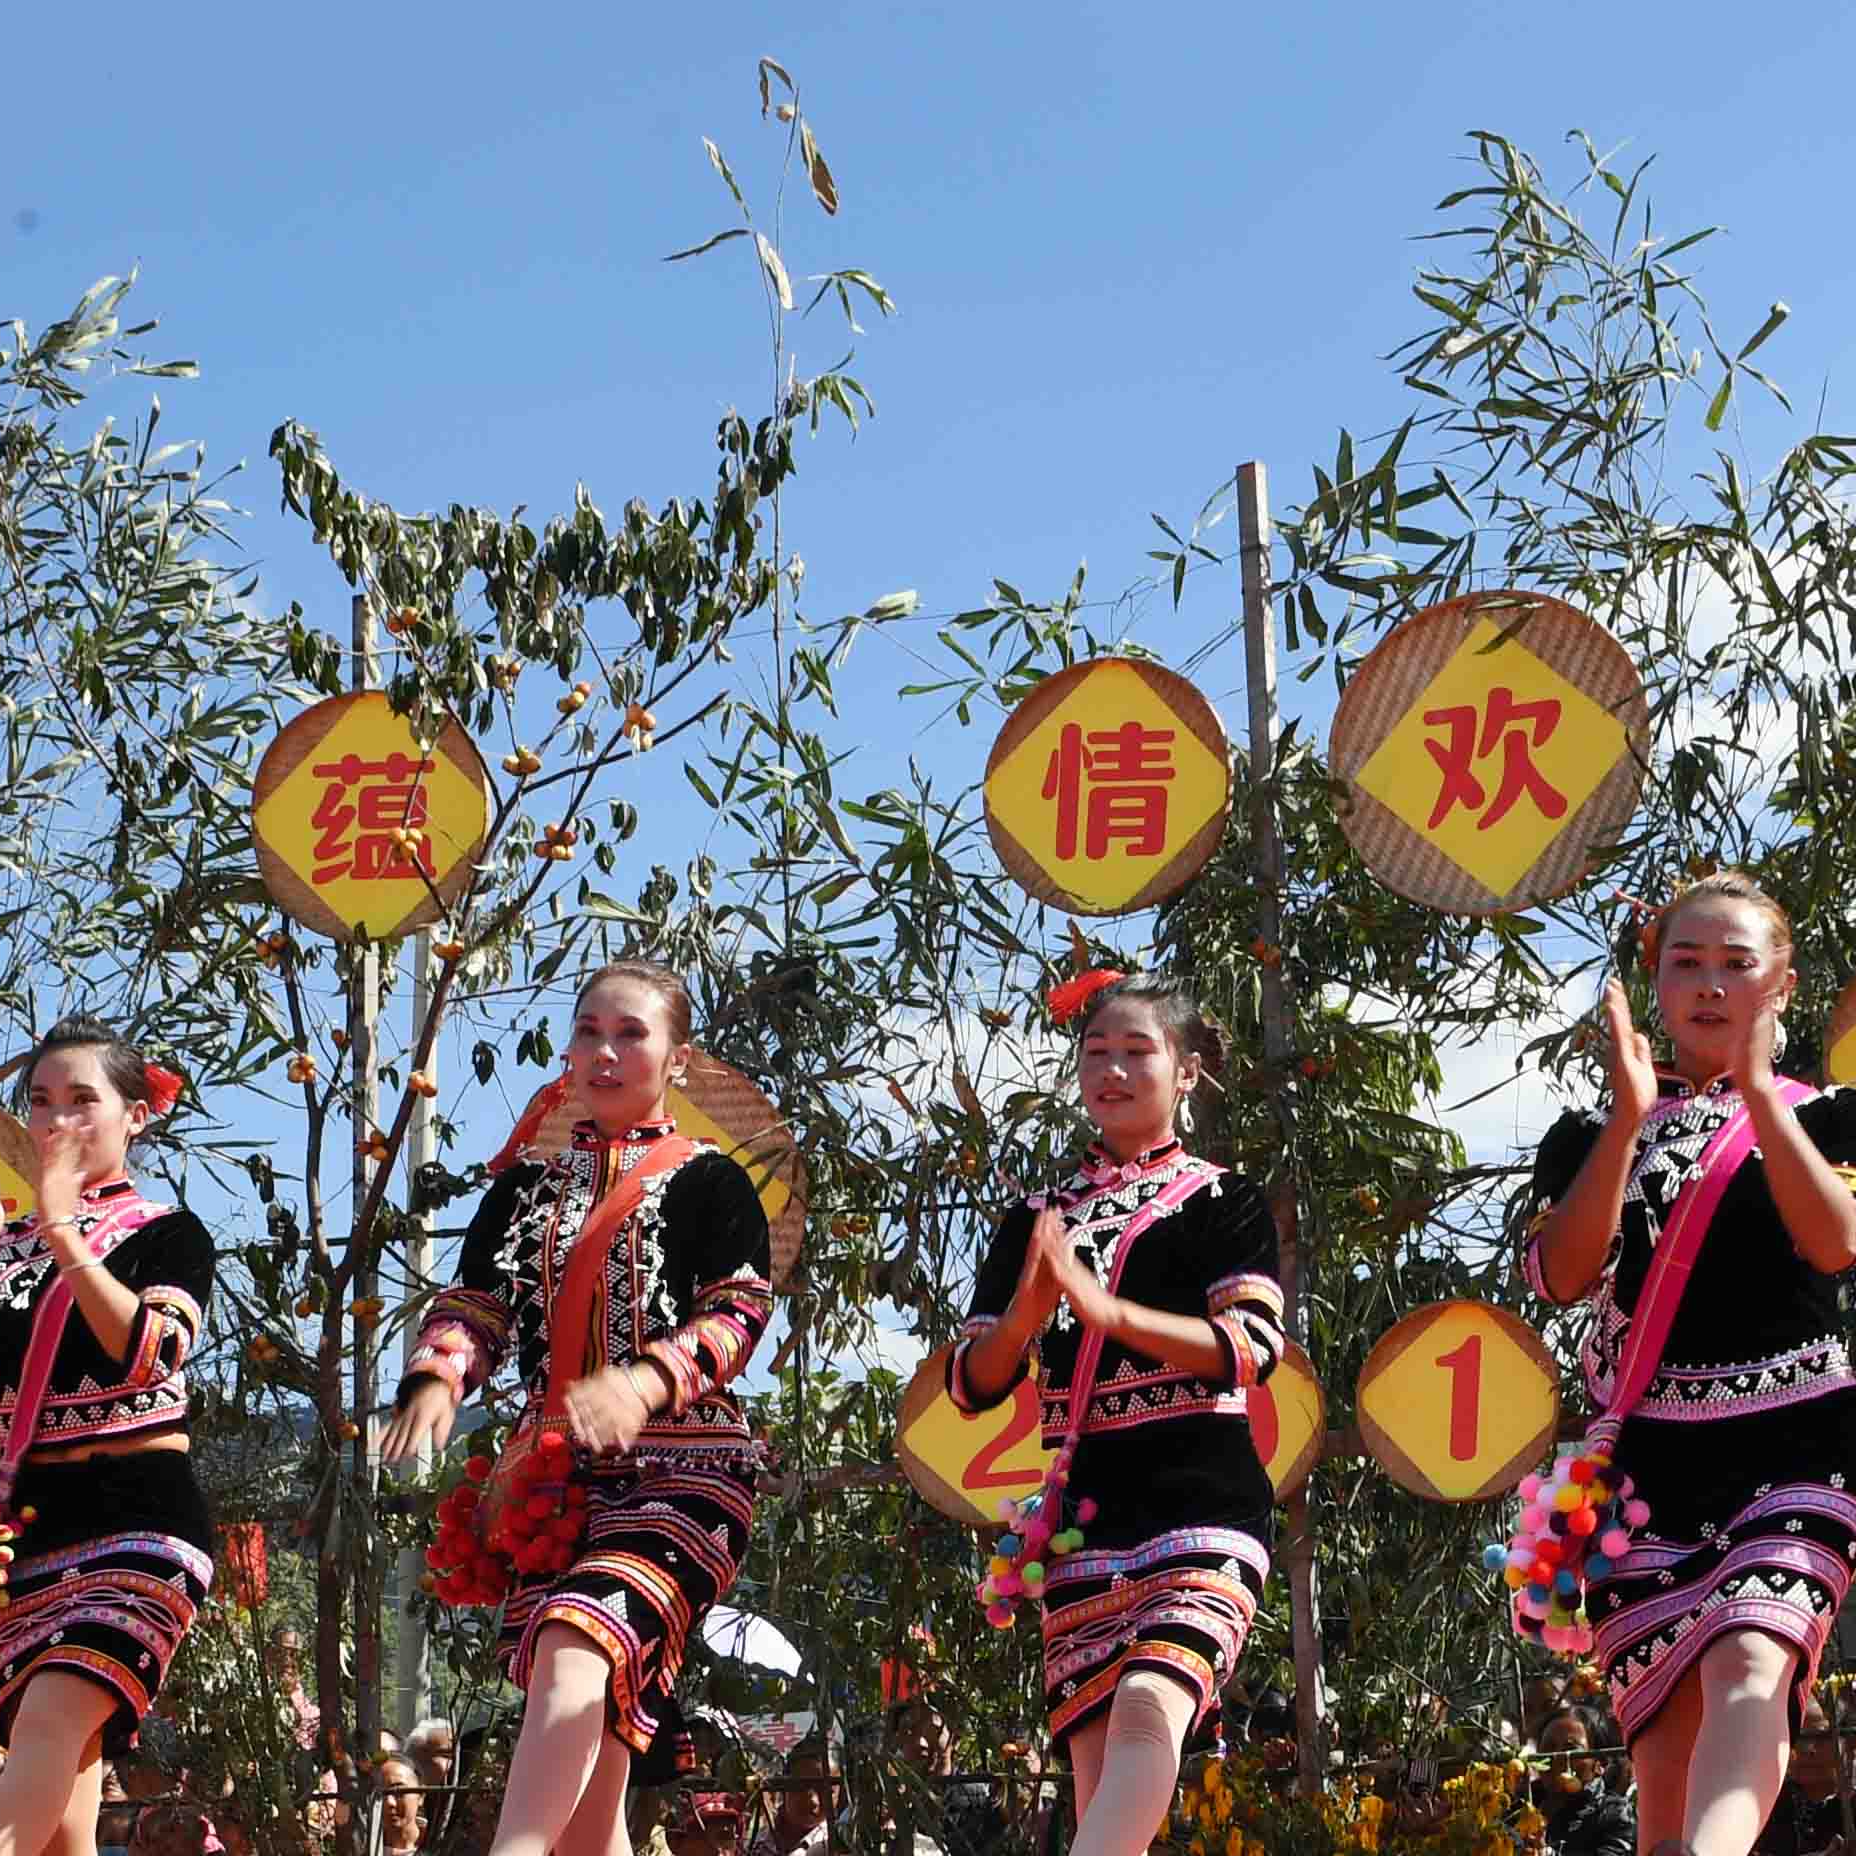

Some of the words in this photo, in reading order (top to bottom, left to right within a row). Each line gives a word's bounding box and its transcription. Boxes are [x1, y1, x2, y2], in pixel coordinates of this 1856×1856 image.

[312, 751, 437, 885] 蕴
[1042, 721, 1176, 860] 情
[1423, 687, 1567, 832] 欢
[1435, 1334, 1483, 1462] 1
